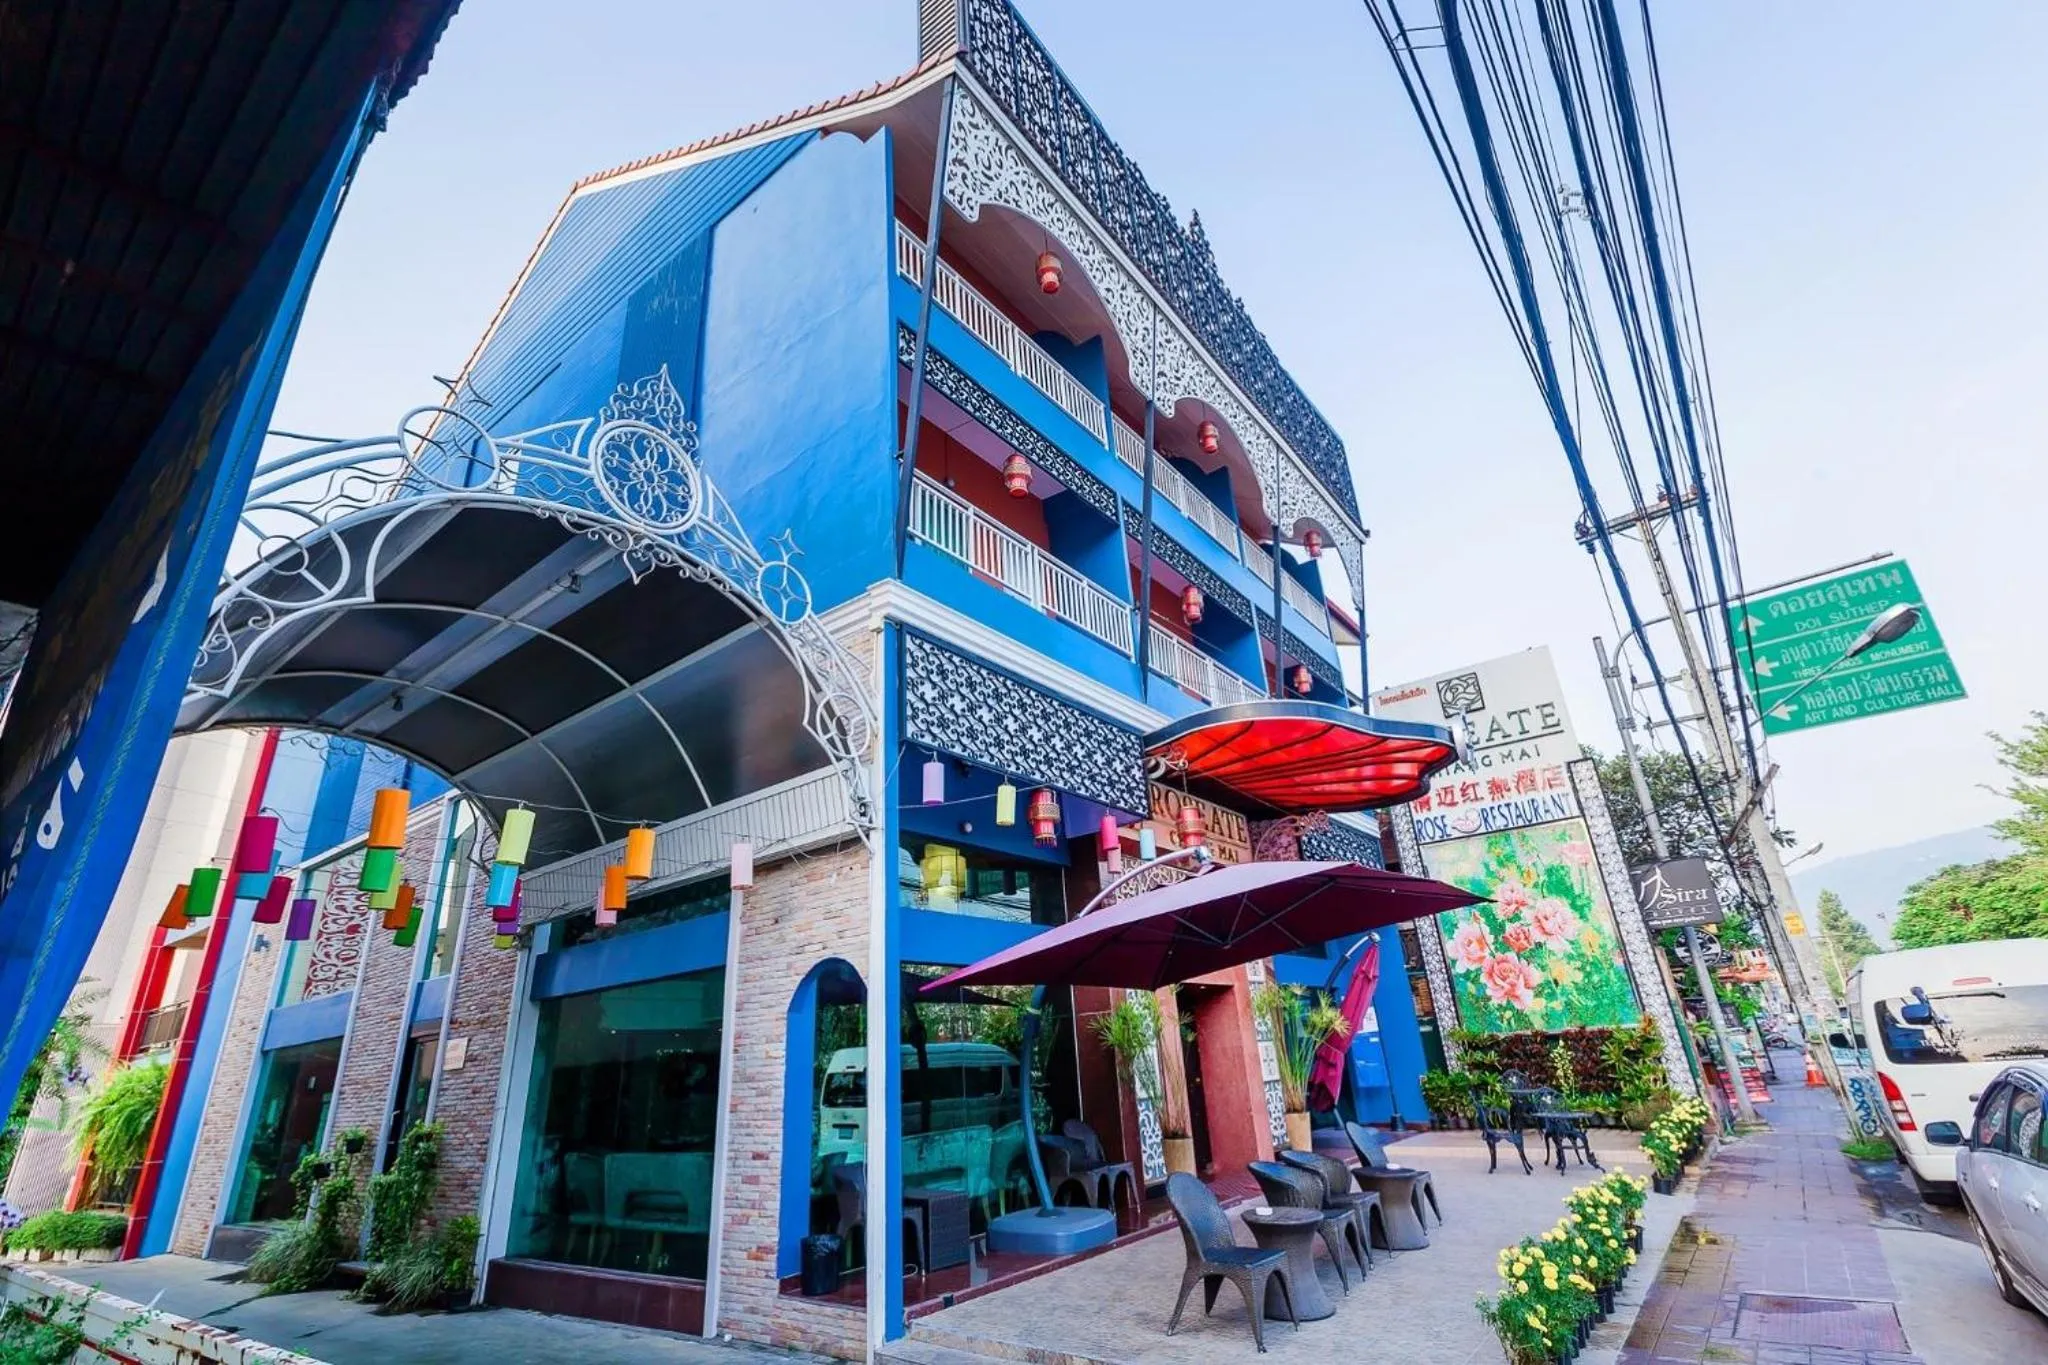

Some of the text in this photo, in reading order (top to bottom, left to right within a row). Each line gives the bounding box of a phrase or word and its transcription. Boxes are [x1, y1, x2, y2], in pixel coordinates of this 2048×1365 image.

[1768, 567, 1902, 617] ดอยสุเทพ
[1795, 600, 1889, 632] DOI SUTHEP
[1792, 663, 1823, 679] THREE
[1870, 641, 1928, 661] MONUMENT
[1464, 702, 1561, 746] EATE
[1804, 683, 1961, 724] ART AND CULTURE HALL
[1500, 743, 1541, 764] MAI
[1416, 792, 1573, 842] ROSE RESTAURANT
